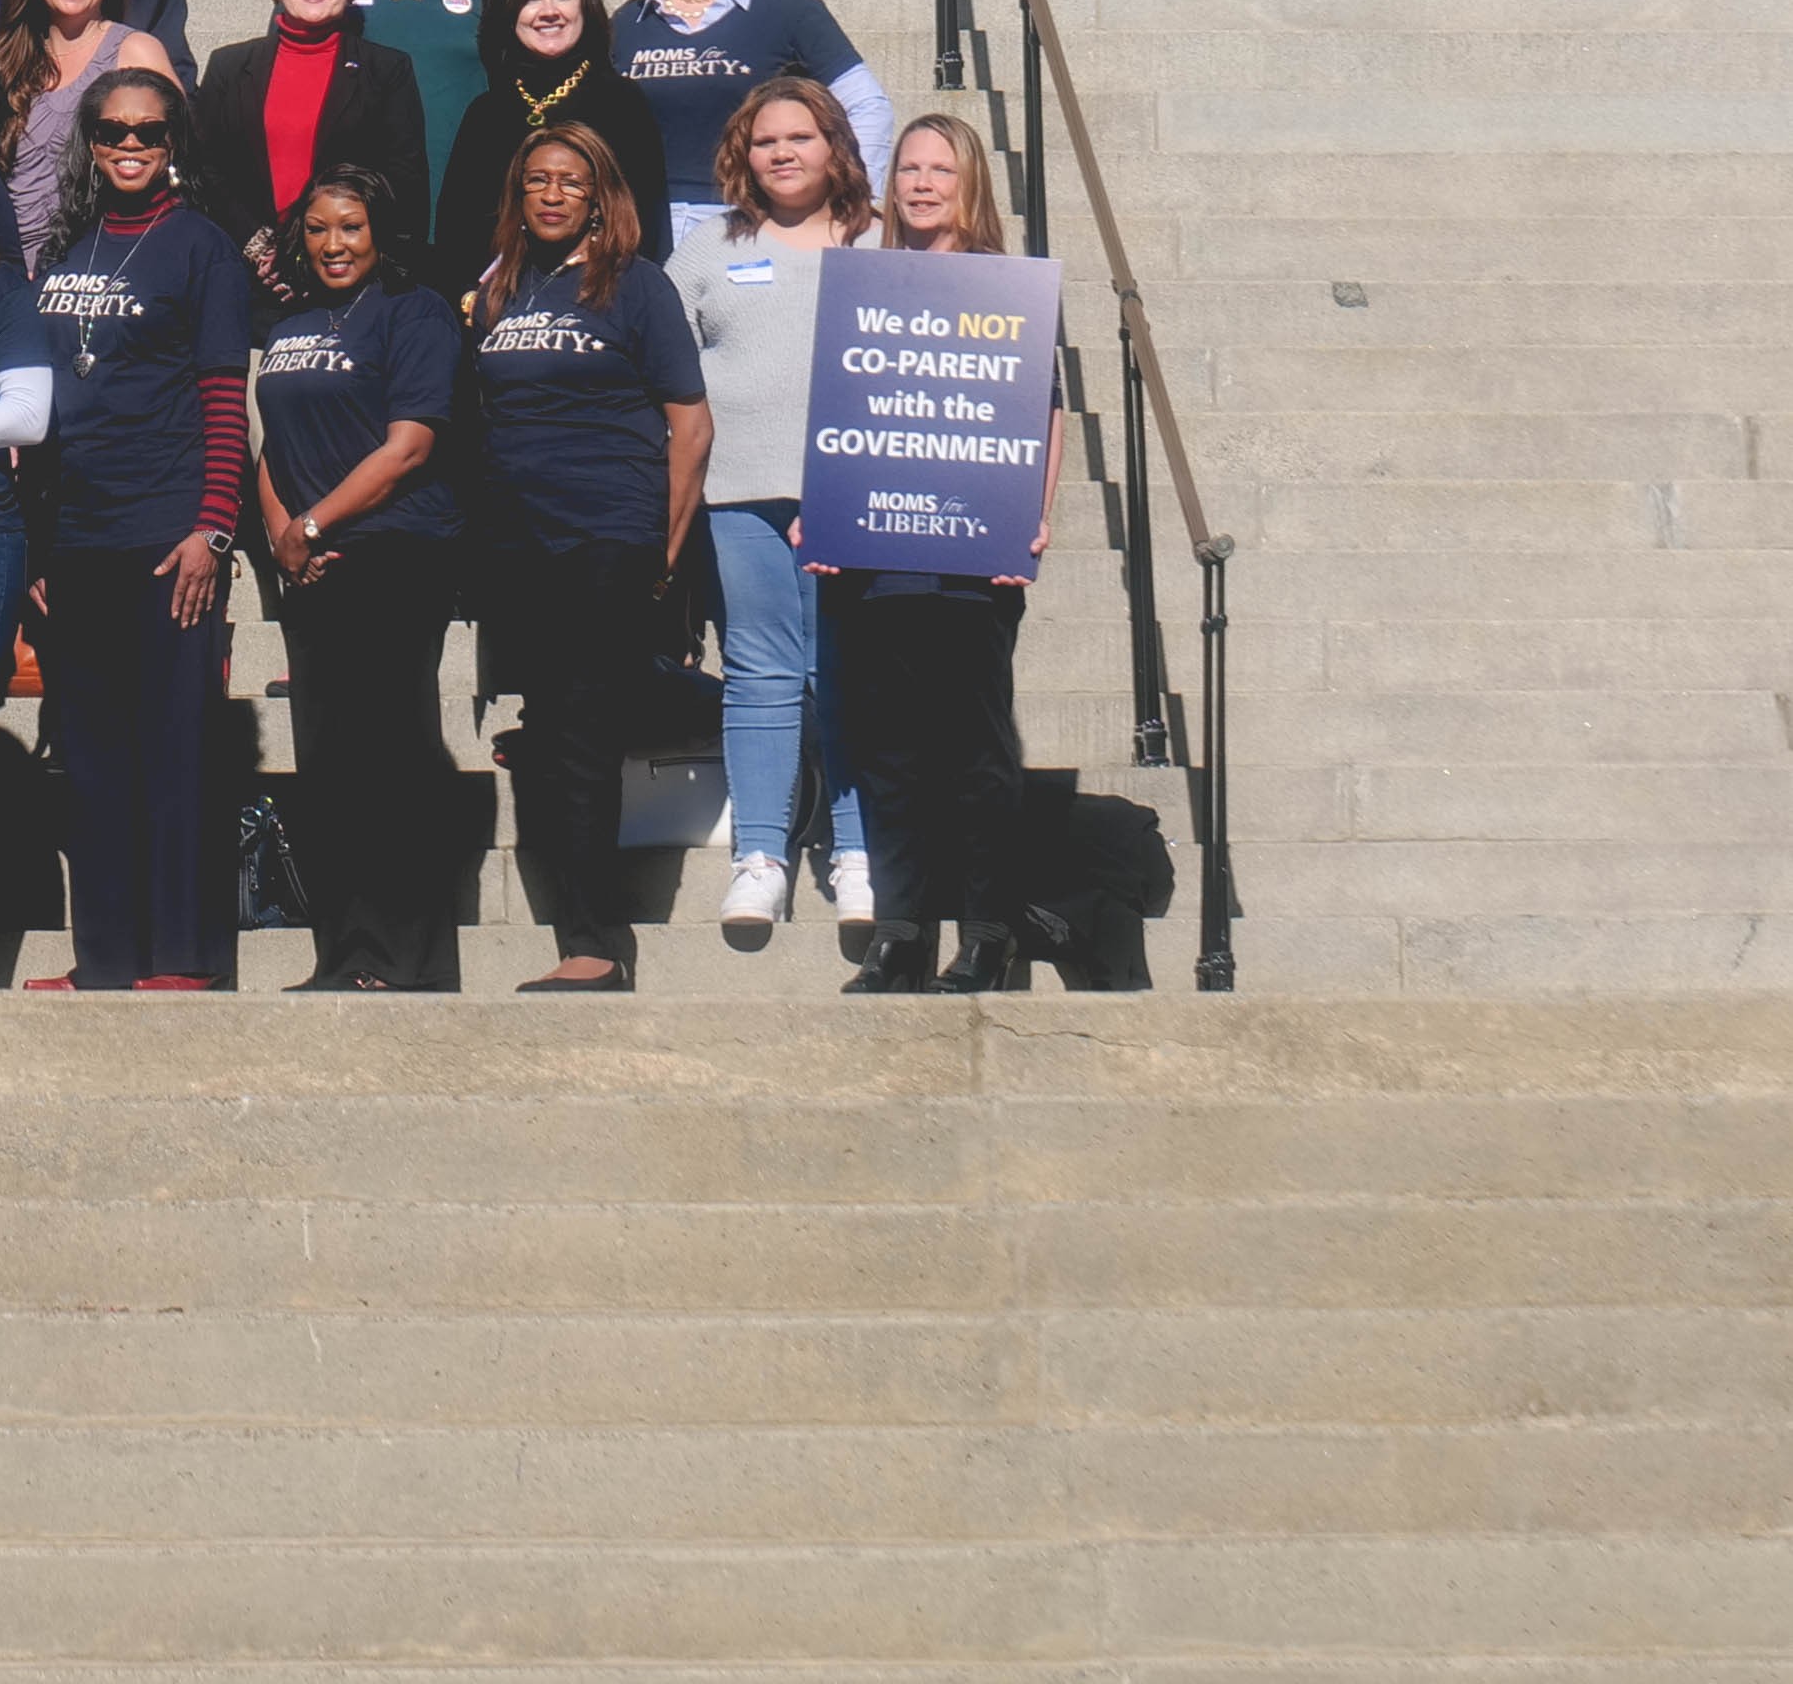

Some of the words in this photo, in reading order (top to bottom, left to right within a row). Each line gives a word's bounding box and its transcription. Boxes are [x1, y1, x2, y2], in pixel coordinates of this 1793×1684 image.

[632, 47, 696, 63] MOMS
[697, 46, 727, 61] for
[629, 59, 740, 79] LIBERTY
[42, 273, 109, 293] MOMS
[37, 292, 135, 316] LIBERTY
[492, 311, 552, 335] MOMS
[856, 307, 903, 333] We
[909, 310, 950, 337] do
[958, 312, 1026, 341] NOT
[268, 334, 321, 355] MOMS
[480, 329, 592, 353] LIBERTY
[258, 350, 345, 376] LIBERTY
[842, 347, 1022, 382] CO-PARENT
[868, 390, 935, 418] with
[943, 393, 995, 421] the
[816, 427, 1042, 465] GOVERNMENT
[868, 491, 937, 513] MOMS
[868, 512, 980, 538] LIBERTY
